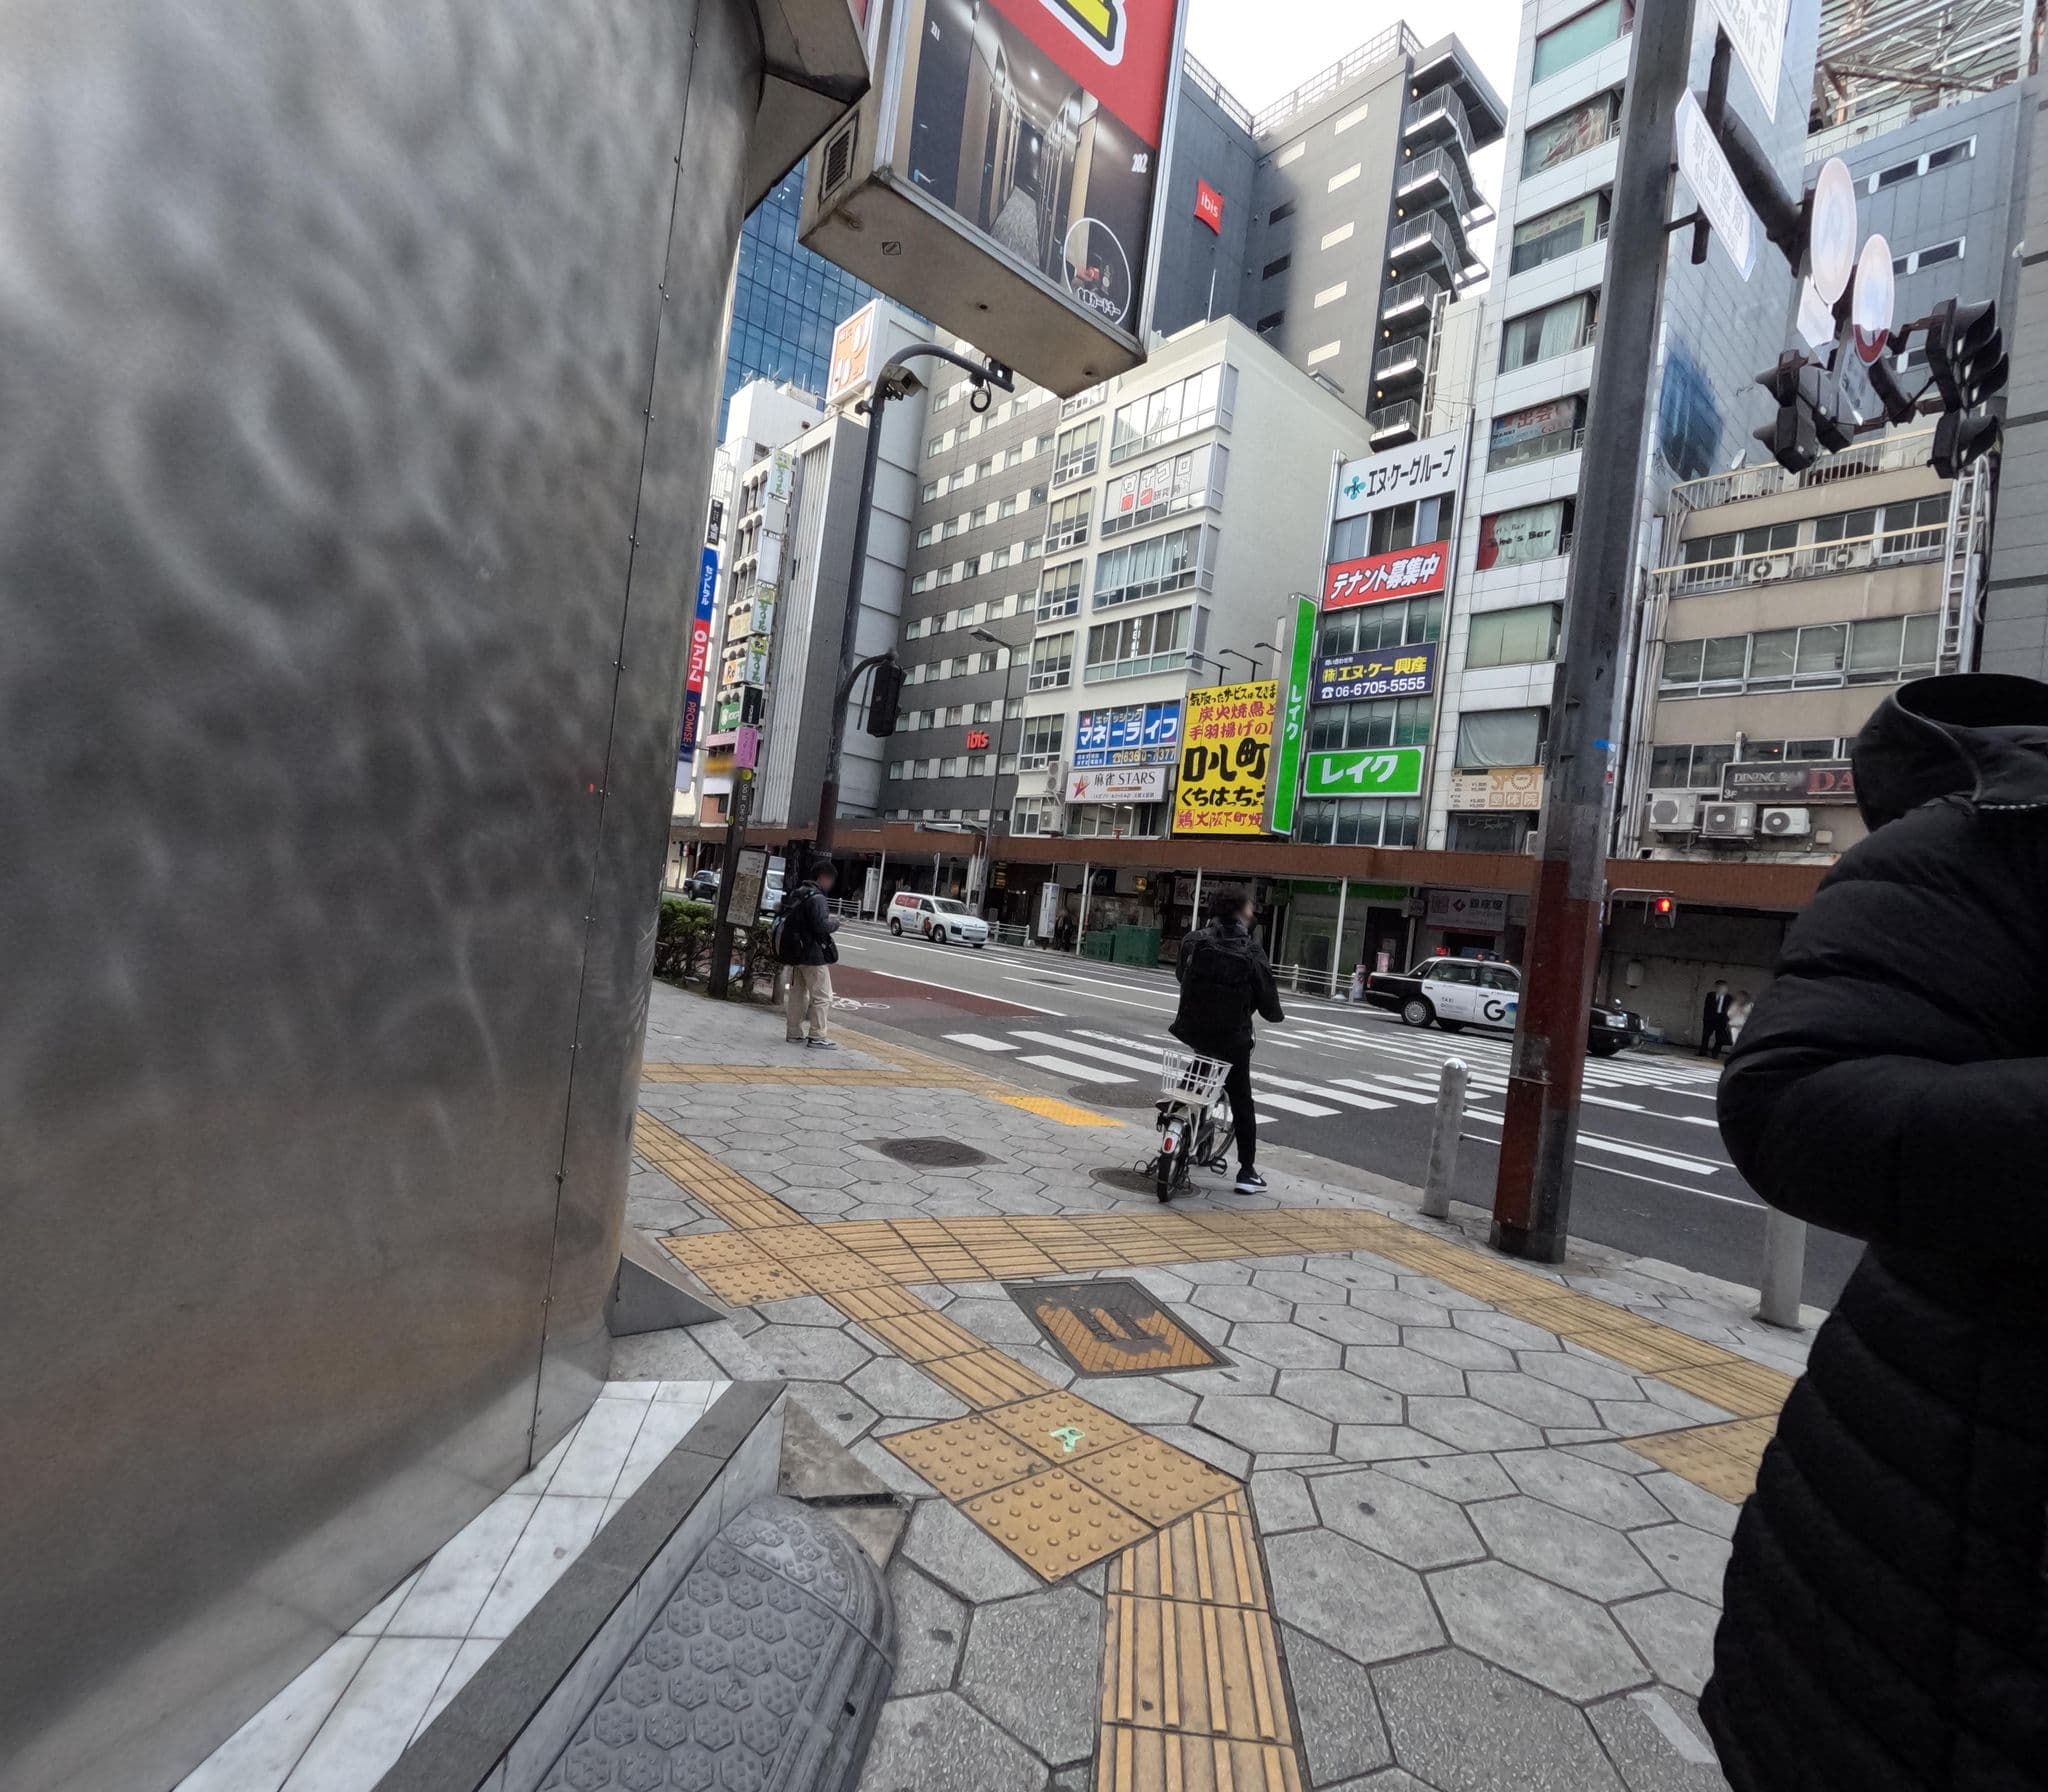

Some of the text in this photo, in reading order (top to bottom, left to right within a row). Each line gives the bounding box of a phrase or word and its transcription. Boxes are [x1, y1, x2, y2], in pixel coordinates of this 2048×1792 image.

[1201, 191, 1219, 218] ibis
[1330, 552, 1442, 600] テナント募集中
[1335, 676, 1426, 698] 06-6705-5555
[684, 701, 697, 743] PROMISE
[1286, 684, 1302, 740] レイク
[967, 730, 989, 749] ibis
[1080, 717, 1178, 745] マネーライフ
[1189, 719, 1273, 741] 手羽揚げの
[1118, 771, 1156, 785] STARS
[1321, 754, 1399, 785] レイク
[1806, 771, 1854, 791] DA
